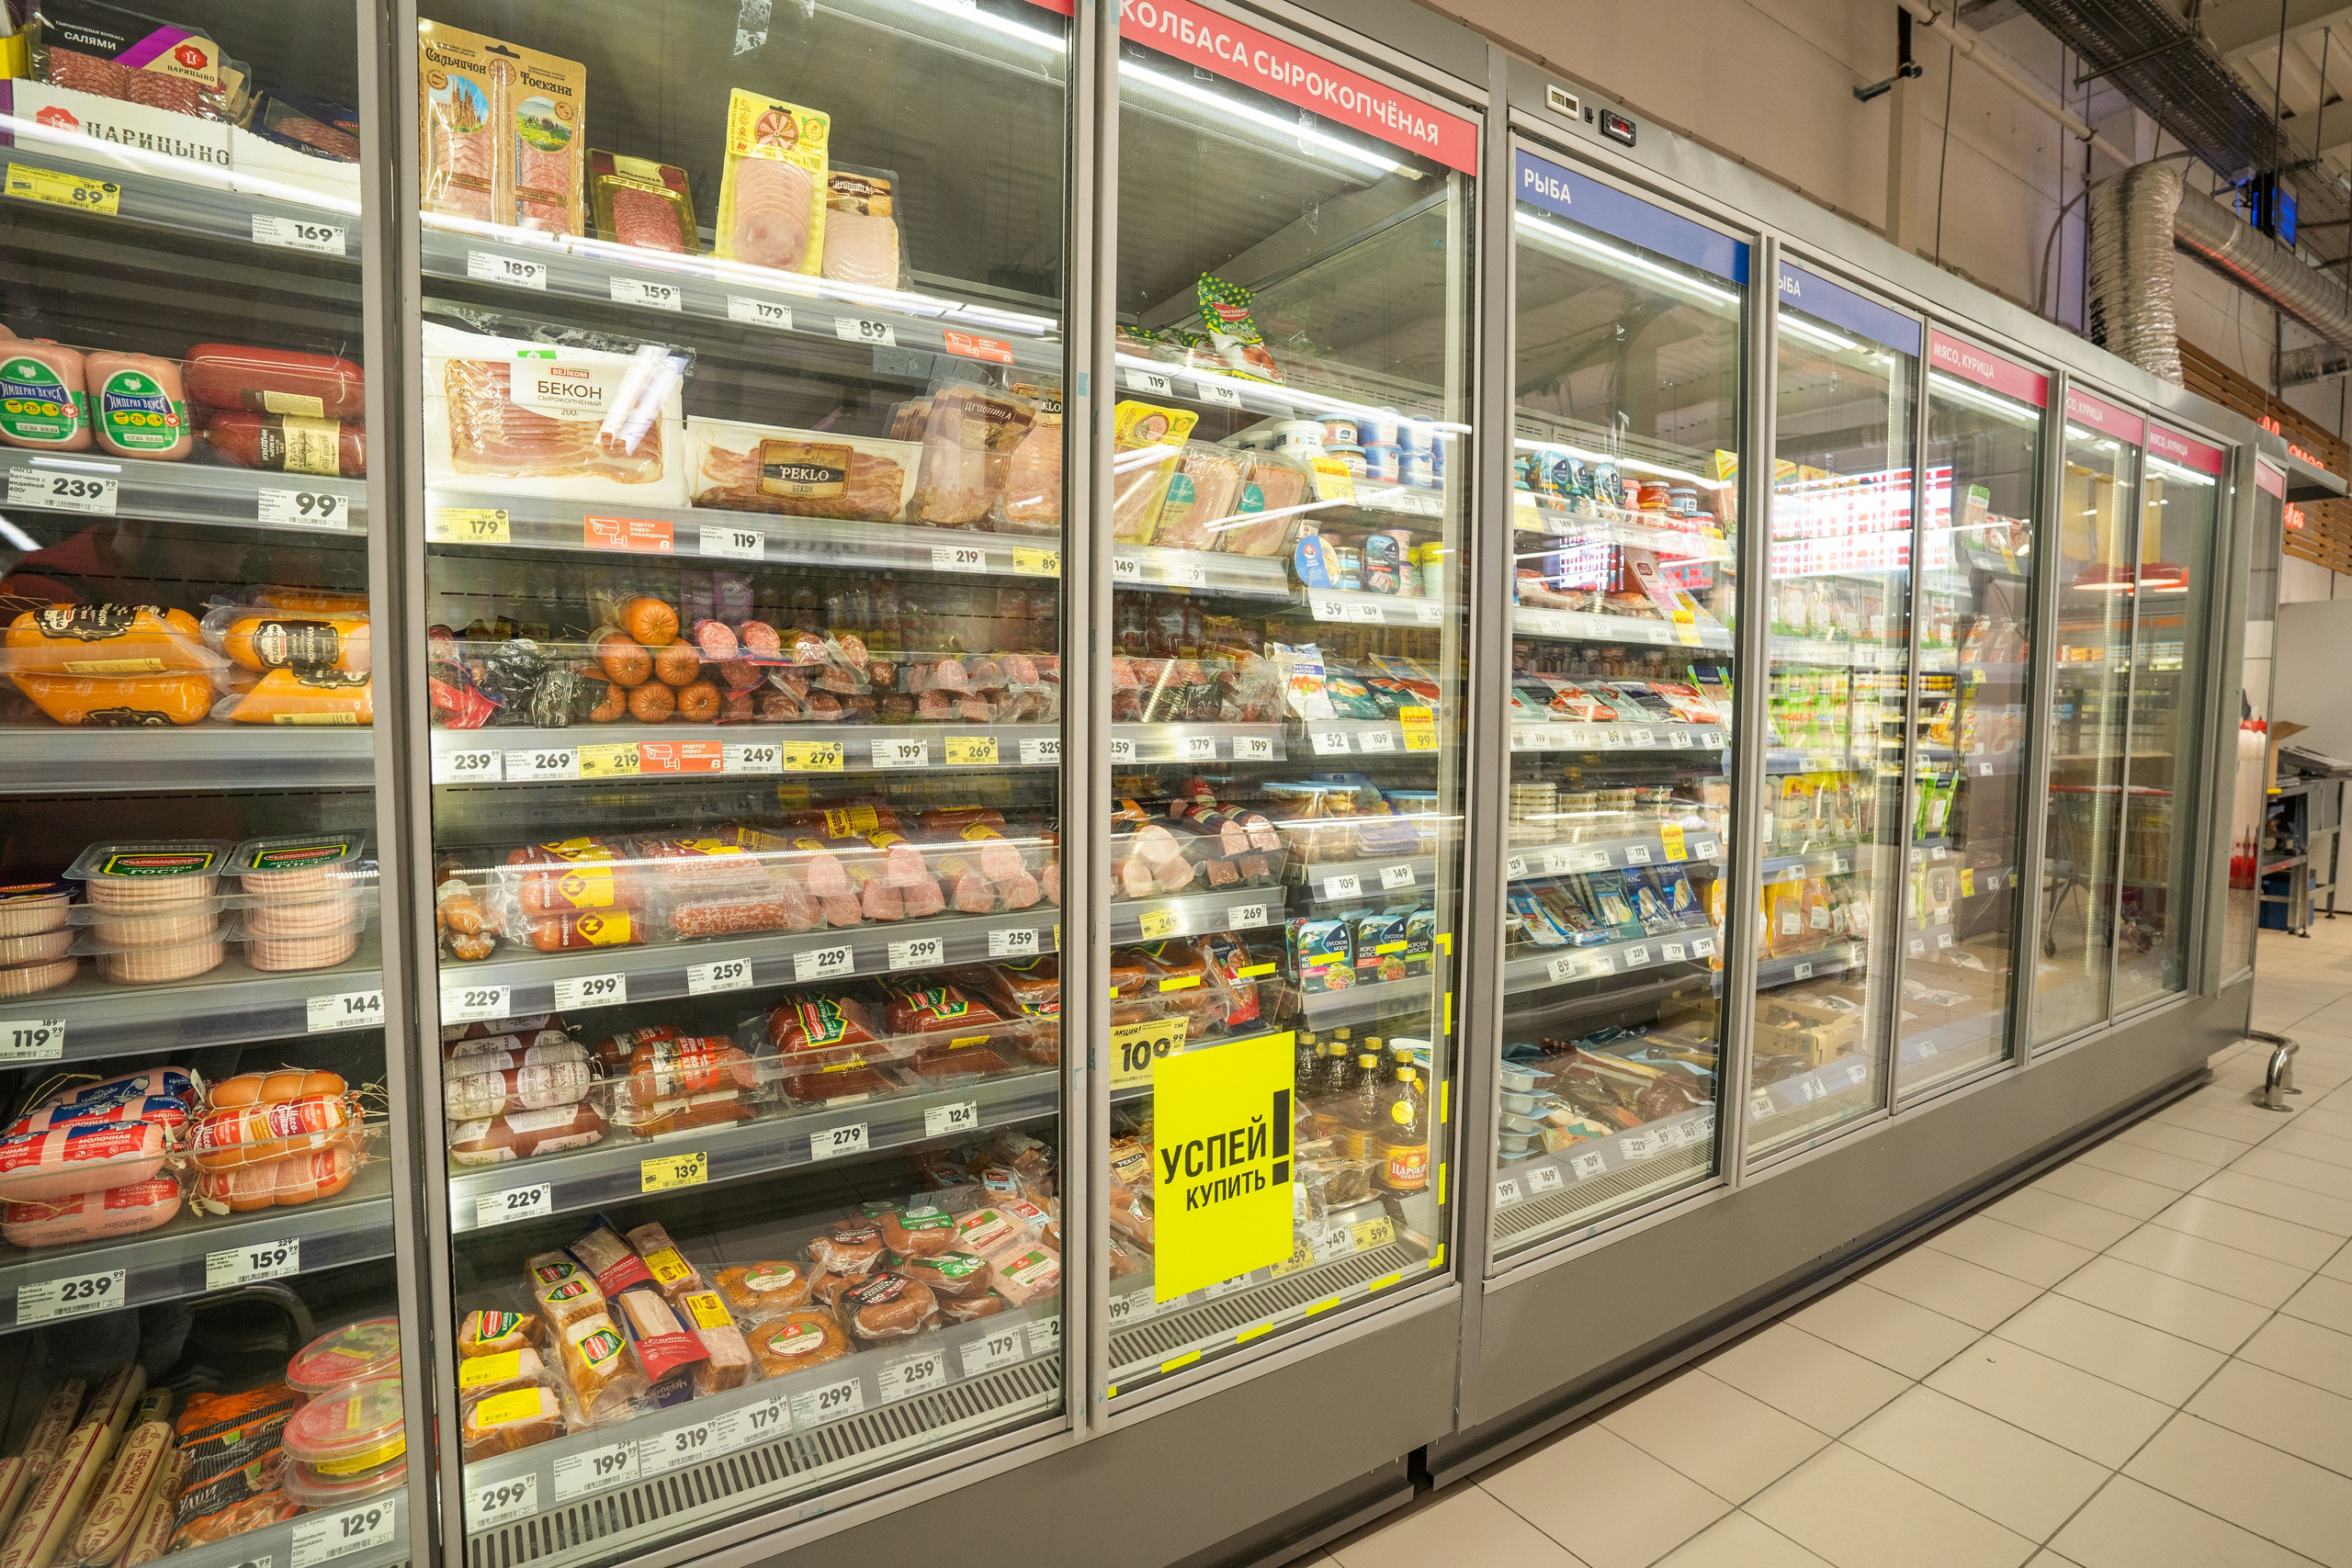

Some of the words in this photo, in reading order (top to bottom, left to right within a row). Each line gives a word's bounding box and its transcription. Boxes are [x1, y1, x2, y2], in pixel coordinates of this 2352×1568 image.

[64, 31, 117, 51] САЛЯМИ
[426, 48, 486, 74] Сальчичон
[167, 64, 215, 83] ЦАРИЦЫНО
[1120, 0, 1249, 68] КОЛБАСА
[1254, 50, 1439, 146] СЫРОКОПЧЁНАЯ
[520, 71, 572, 96] Тоскана
[86, 121, 230, 166] ЦАРИЦЫНО
[619, 169, 661, 184] МИЛАНСКАЯ
[1524, 168, 1572, 204] РЫБА
[72, 187, 103, 204] 89
[295, 224, 333, 243] 169
[503, 260, 536, 277] 189
[641, 284, 671, 300] 159
[1779, 277, 1801, 298] ЫБА
[757, 304, 784, 319] 179
[860, 321, 886, 337] 89
[1934, 342, 1961, 367] МЯСО,
[1962, 354, 1995, 379] КУРИЦА
[1148, 375, 1165, 389] 119
[2, 382, 36, 397] ИМПЕРИЯ
[37, 385, 63, 401] ВКУСА
[537, 381, 602, 400] БЕКОН
[1216, 387, 1233, 398] 139
[107, 393, 141, 411] ИМПЕРИЯ
[142, 397, 165, 412] ВКУСА
[537, 395, 602, 407] СЫРОКОПЧЕНЫЙ
[965, 401, 1012, 421] ДРОВНИЦА
[2078, 403, 2103, 423] КУРИЦА
[2167, 437, 2188, 457] КУРИЦА
[780, 465, 829, 481] PEKLO
[1317, 465, 1347, 478] АКЦИЯ!
[9, 480, 45, 489] индейкой
[52, 478, 104, 499] 239
[792, 484, 814, 494] БЕКОН
[1333, 488, 1348, 498] 99
[296, 492, 336, 517] 99
[469, 520, 498, 535] 179
[733, 534, 755, 547] 119
[956, 550, 978, 563] 219
[1042, 559, 1056, 570] 89
[1114, 560, 1134, 572] 149
[1326, 603, 1341, 615] 59
[1362, 606, 1377, 615] 139
[1404, 716, 1431, 724] АКЦИЯ!
[1327, 734, 1343, 747] 52
[1373, 733, 1387, 744] 109
[1417, 735, 1430, 746] 99
[1572, 730, 1585, 741] 99
[1608, 731, 1619, 742] 89
[1677, 732, 1687, 742] 99
[1710, 734, 1720, 744] 89
[1039, 741, 1059, 753] 329
[1111, 742, 1130, 753] 259
[1190, 739, 1209, 750] 379
[1250, 740, 1267, 750] 199
[743, 748, 774, 762] 249
[809, 752, 835, 763] 279
[897, 746, 920, 758] 199
[968, 747, 990, 757] 269
[454, 755, 491, 771] 239
[535, 754, 570, 769] 269
[614, 755, 639, 768] 219
[1672, 848, 1682, 856] 209
[1509, 859, 1520, 868] 129
[1554, 855, 1566, 866] 79
[1393, 868, 1408, 879] 149
[1339, 877, 1354, 889] 109
[1243, 908, 1261, 919] 269
[1159, 916, 1177, 930] 249
[1009, 932, 1032, 944] 259
[1700, 941, 1710, 949] 299
[910, 942, 936, 956] 299
[1633, 949, 1644, 958] 229
[818, 950, 845, 967] 229
[1557, 960, 1569, 971] 89
[713, 964, 743, 981] 259
[582, 978, 616, 996] 299
[344, 997, 380, 1015] 144
[464, 991, 501, 1007] 229
[1114, 1026, 1141, 1036] АКЦИЯ!
[12, 1030, 50, 1048] 119
[1121, 1038, 1170, 1072] 109
[1758, 1100, 1769, 1111] 269
[949, 1110, 969, 1123] 124
[833, 1129, 860, 1145] 279
[1659, 1132, 1668, 1143] 89
[1683, 1127, 1695, 1137] 149
[78, 1134, 130, 1145] МОЛОЧНАЯ
[1631, 1141, 1645, 1151] 229
[1160, 1114, 1266, 1184] УСПЕЙ
[1116, 1154, 1141, 1168] PEKLO
[1584, 1155, 1598, 1168] 109
[674, 1165, 697, 1179] 139
[1541, 1170, 1555, 1181] 169
[119, 1184, 169, 1193] МОЛОЧНАЯ
[1186, 1168, 1266, 1211] КУПИТЬ
[1498, 1183, 1513, 1196] 199
[506, 1190, 541, 1210] 229
[1371, 1227, 1387, 1239] 599
[250, 1249, 287, 1269] 159
[1287, 1250, 1306, 1264] 459
[599, 1257, 639, 1278] ГРУДИНКА
[62, 1277, 112, 1302] 239
[1109, 1301, 1129, 1317] 199
[644, 1337, 687, 1346] ГРУДИНКА
[988, 1337, 1012, 1356] 179
[904, 1362, 934, 1382] 259
[819, 1385, 852, 1409] 299
[750, 1405, 780, 1428] 179
[617, 1440, 631, 1450] 279
[676, 1427, 707, 1451] 319
[594, 1452, 628, 1475] 199
[120, 1449, 152, 1495] ПЕЧЕНОЧНАЯ
[31, 1460, 70, 1514] ПЕЧЕНОЧНАЯ
[481, 1483, 526, 1512] 299
[309, 1517, 327, 1527] Хумус
[340, 1509, 381, 1537] 129
[292, 1539, 323, 1551] орешками
